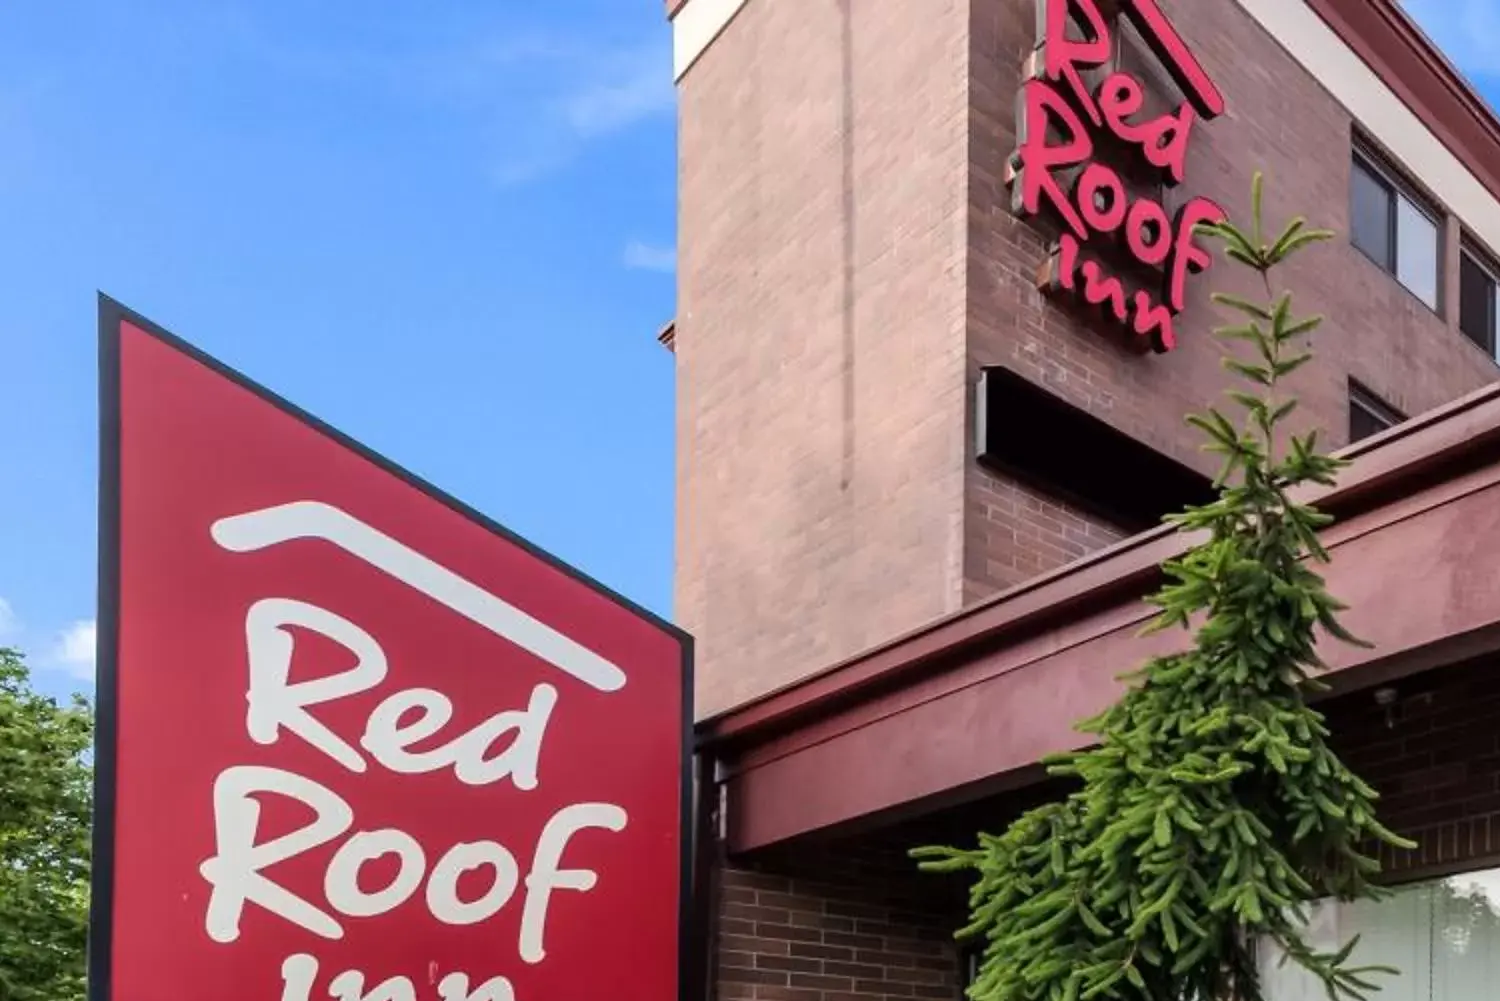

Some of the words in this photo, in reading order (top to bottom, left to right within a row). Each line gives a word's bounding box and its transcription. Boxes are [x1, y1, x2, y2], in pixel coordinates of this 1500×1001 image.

[1044, 0, 1195, 184] Red
[1020, 79, 1229, 312] Roof
[1058, 233, 1176, 350] Inn
[245, 597, 559, 791] Red
[199, 765, 628, 964] Roof
